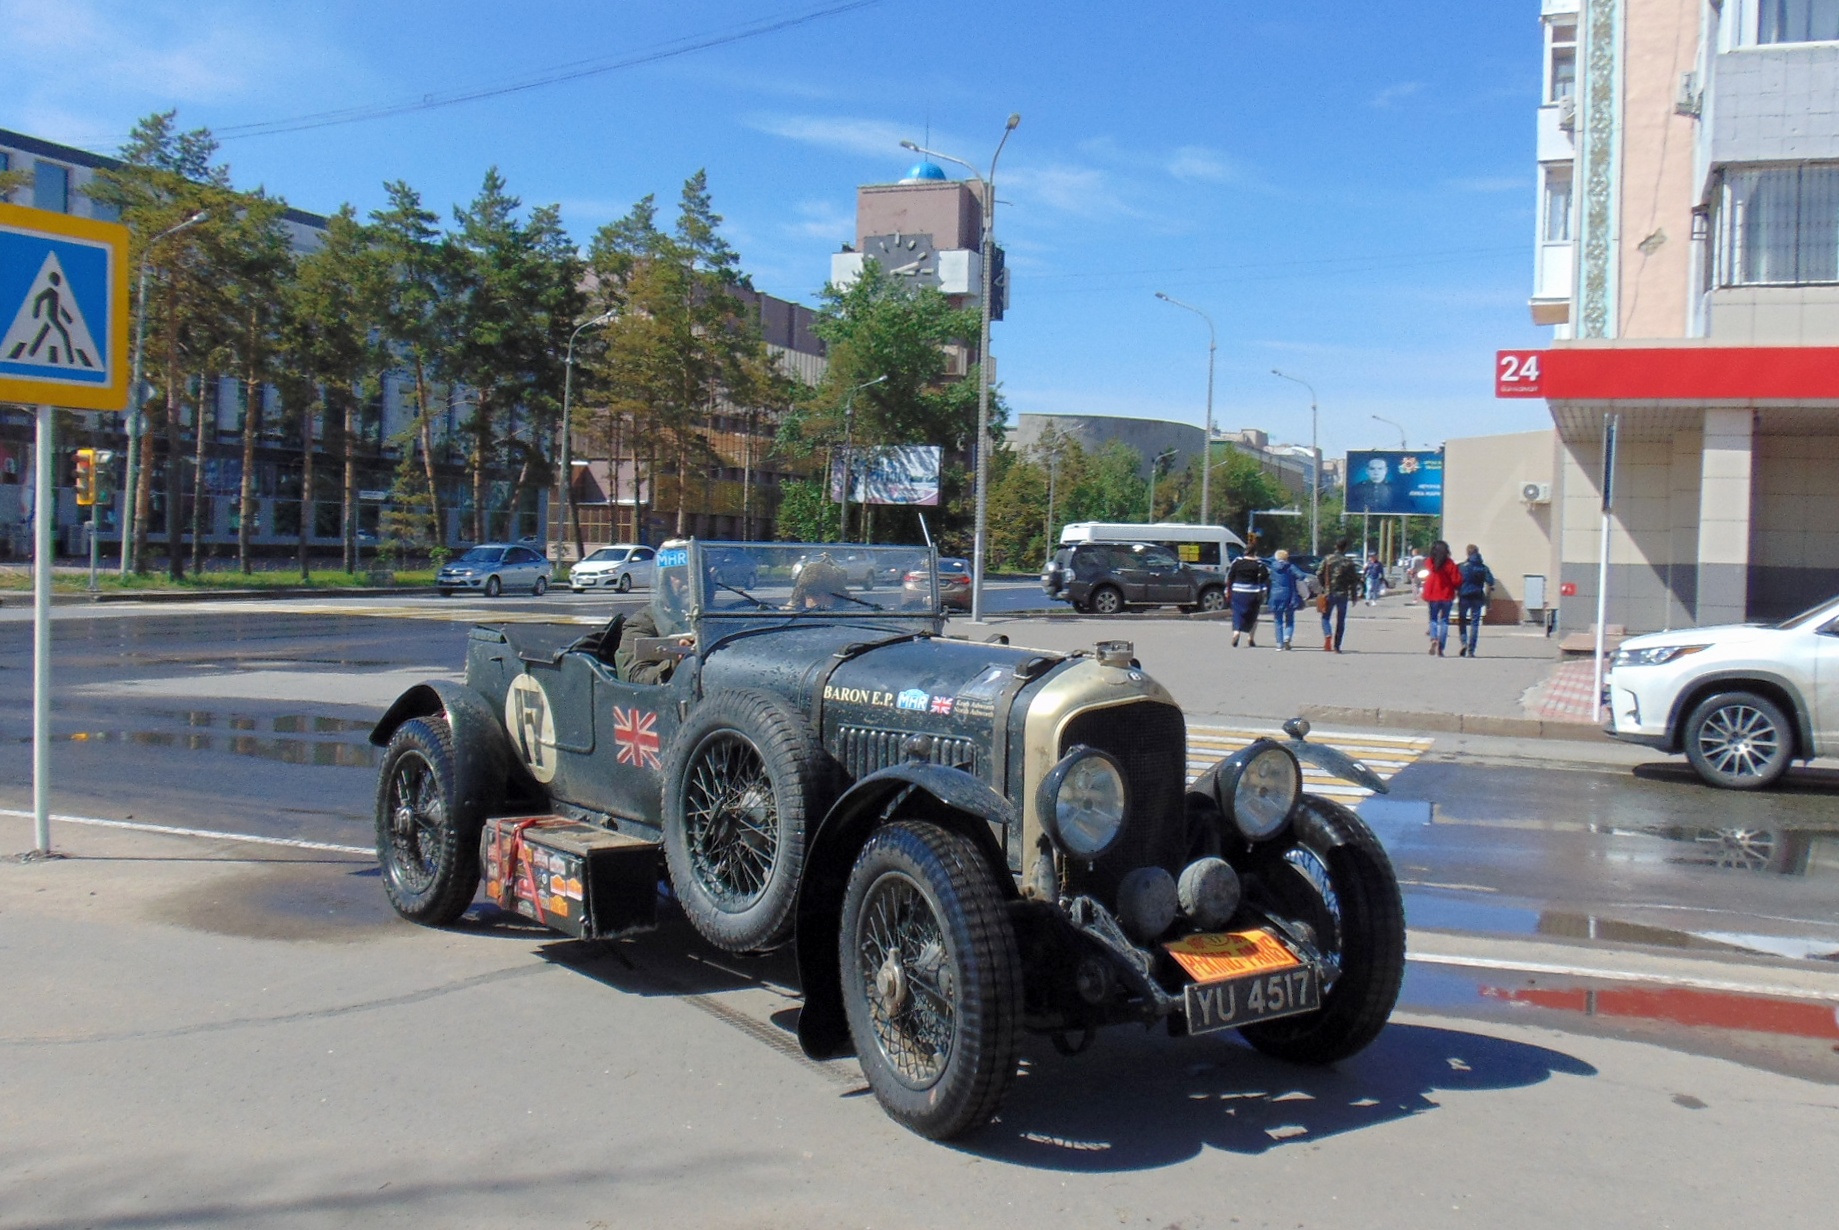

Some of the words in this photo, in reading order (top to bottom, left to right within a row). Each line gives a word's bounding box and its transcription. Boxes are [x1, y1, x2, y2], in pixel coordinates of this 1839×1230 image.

[1500, 355, 1540, 382] 24
[656, 552, 687, 567] MHR
[823, 685, 871, 704] BARON
[871, 691, 894, 707] E.P.
[898, 692, 928, 710] MHR
[1196, 985, 1236, 1025] YU
[1247, 971, 1309, 1014] 4517
